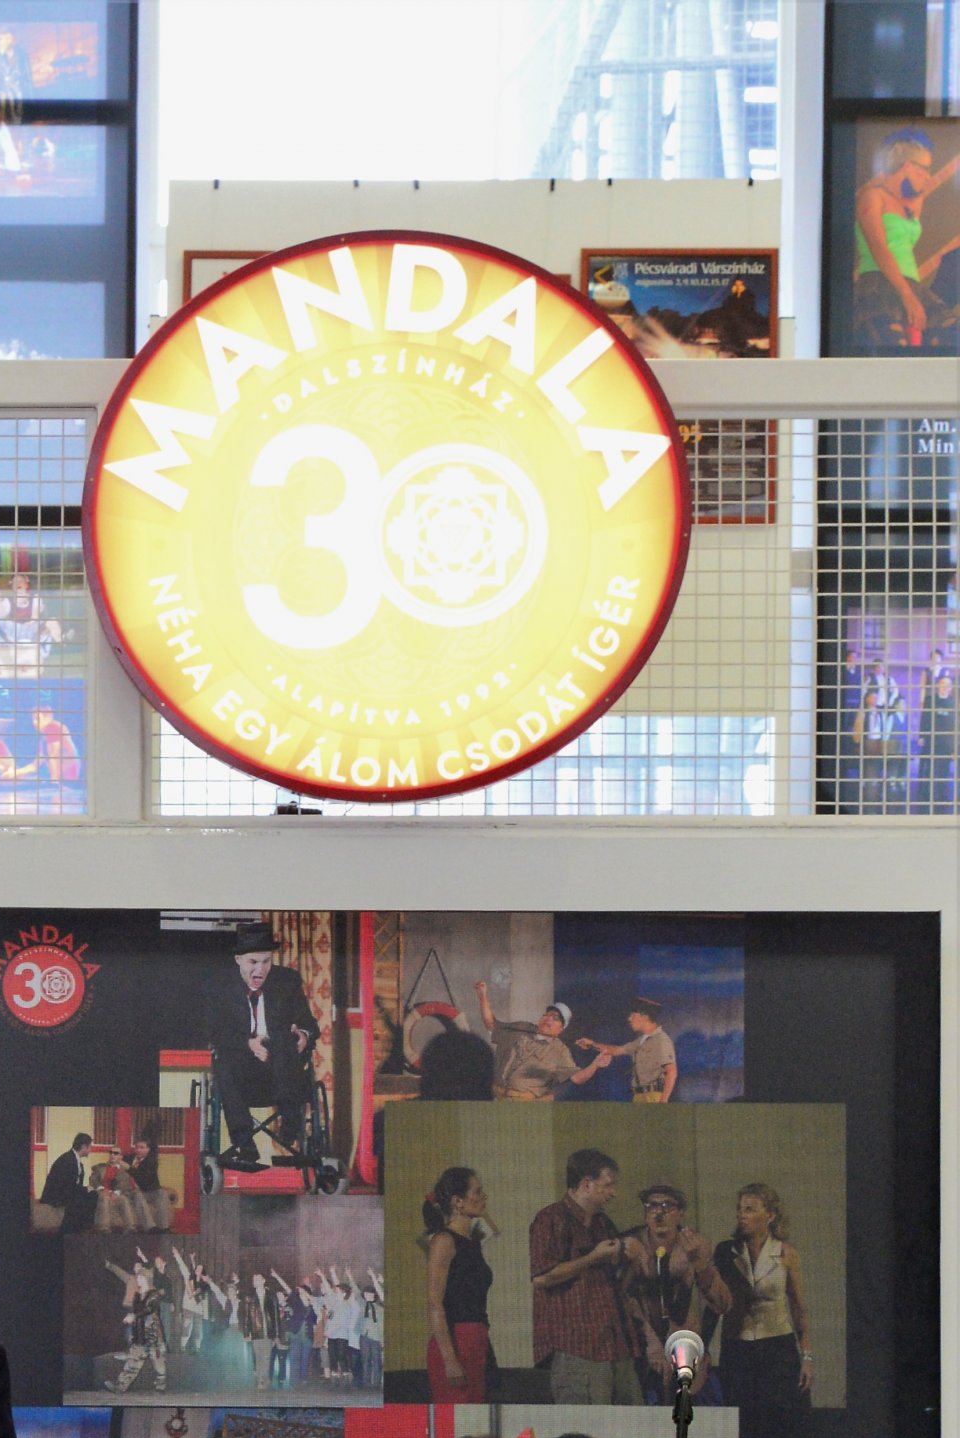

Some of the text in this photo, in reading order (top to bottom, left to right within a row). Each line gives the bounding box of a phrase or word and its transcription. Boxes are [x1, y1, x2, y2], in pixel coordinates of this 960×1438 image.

[634, 262, 697, 275] Pécsváradi
[701, 262, 765, 275] Várszínház
[103, 243, 672, 512] MANDALA
[272, 349, 514, 413] DALSZÍNHÁZ
[148, 574, 641, 787] NÉHA EGY ÁLOM CSODÁT ÍGÉR
[272, 671, 510, 725] ALAPÍTVA 1992
